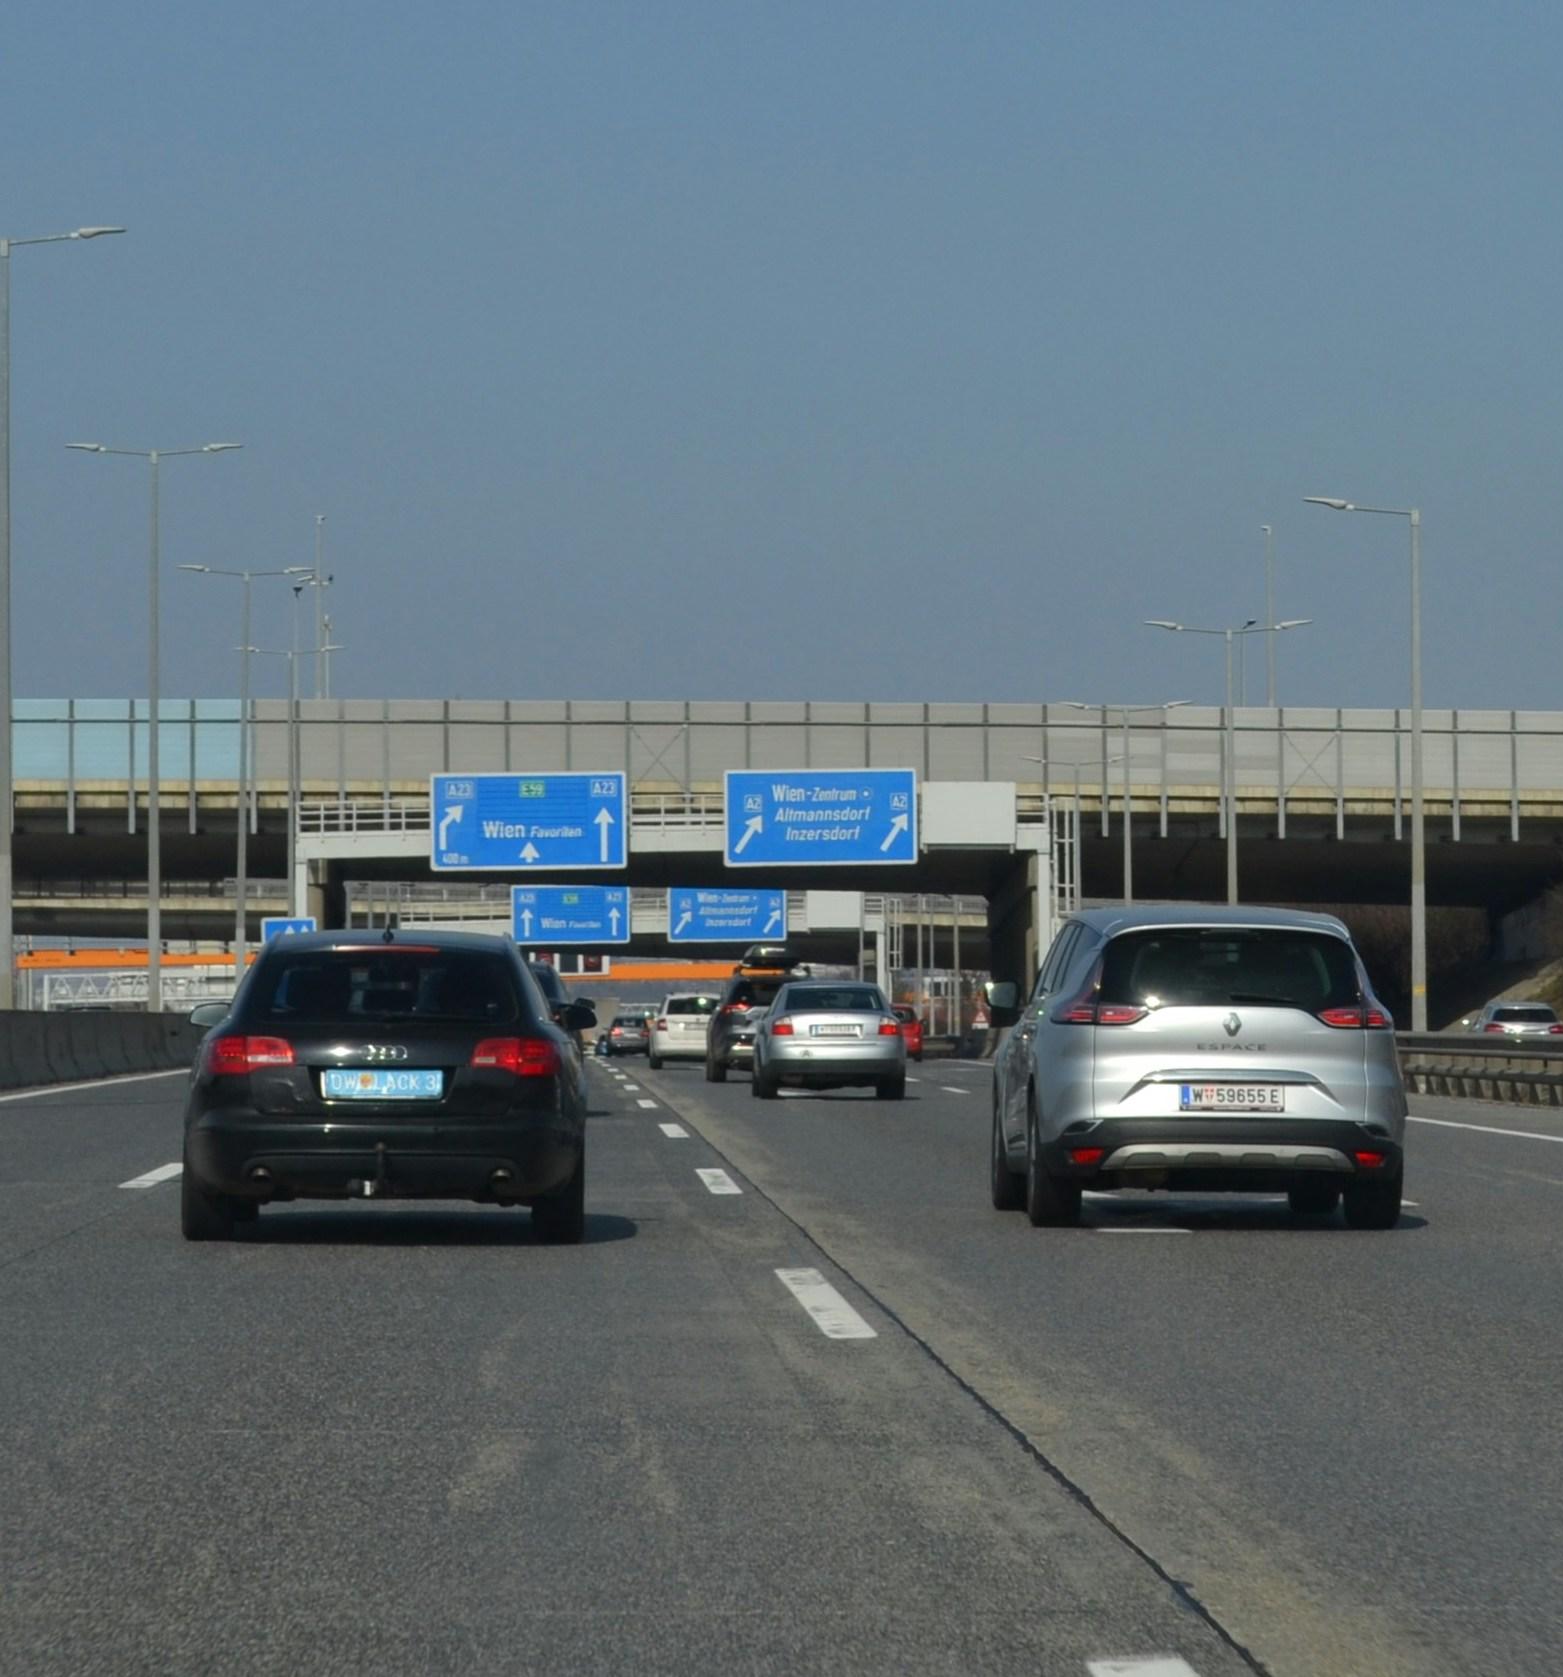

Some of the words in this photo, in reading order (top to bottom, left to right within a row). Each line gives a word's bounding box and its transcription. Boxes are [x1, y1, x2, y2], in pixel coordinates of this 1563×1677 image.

[449, 783, 471, 796] A23
[592, 781, 616, 795] A23
[746, 797, 762, 810] A2
[891, 795, 907, 808] A2
[774, 806, 871, 823] Altmannsdorf
[482, 820, 526, 838] Wien
[785, 825, 861, 841] Inzersdorf
[1196, 1043, 1267, 1052] ESPACE
